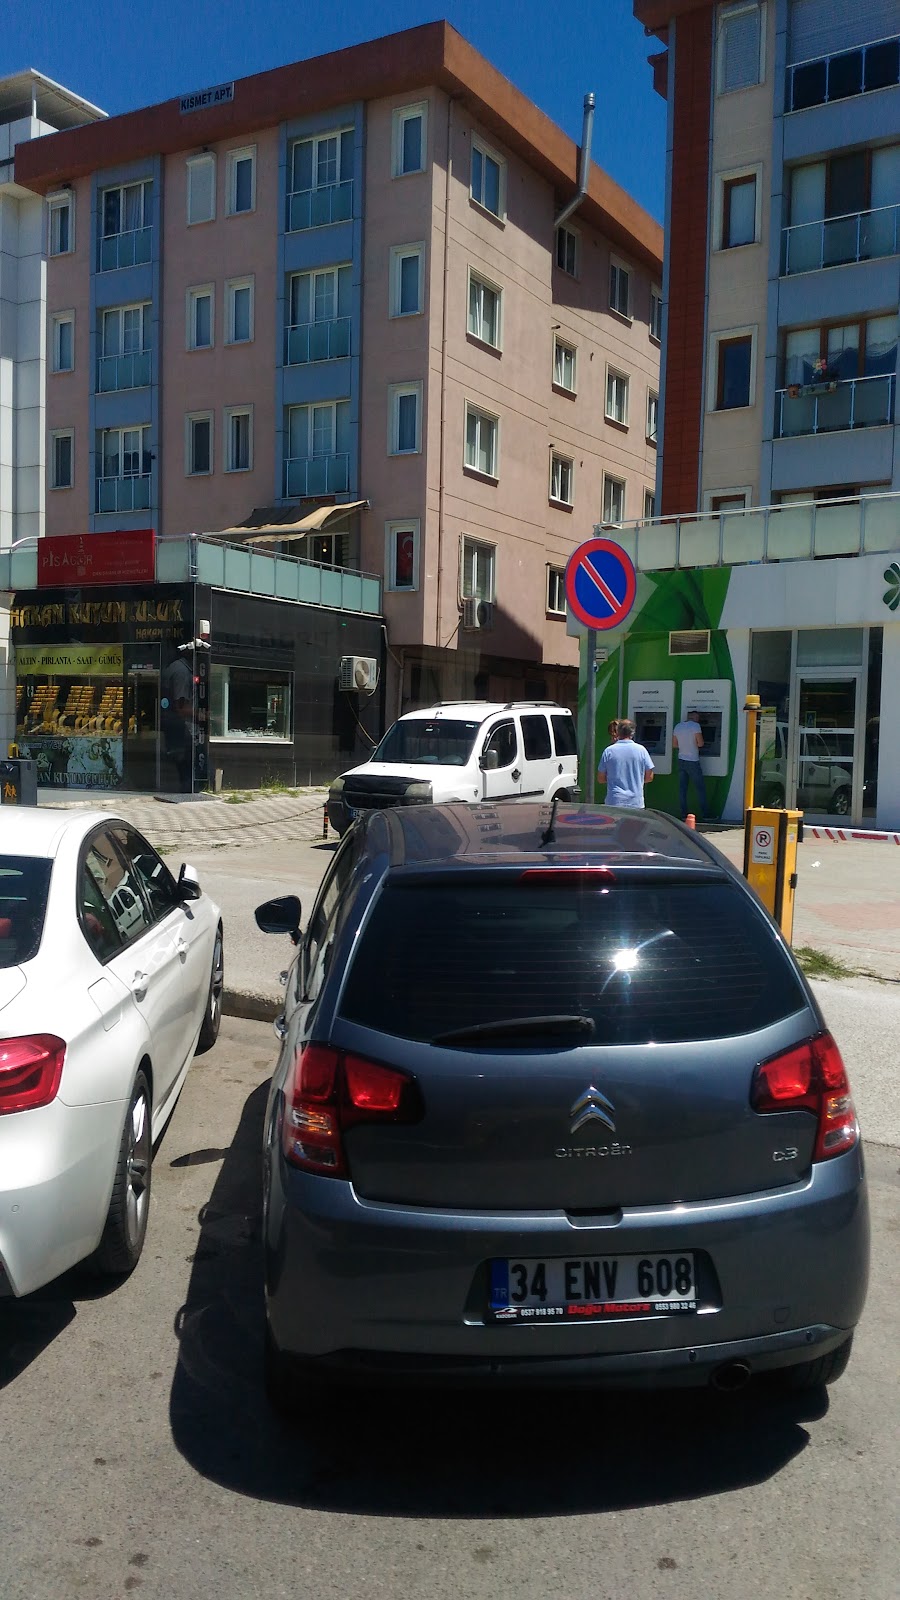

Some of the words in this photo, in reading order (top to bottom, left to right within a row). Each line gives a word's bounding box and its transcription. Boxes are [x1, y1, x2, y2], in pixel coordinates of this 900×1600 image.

[181, 92, 212, 111] KISMET
[214, 86, 232, 101] APT.
[19, 656, 36, 666] ALTIN
[41, 656, 72, 665] PIRLANTA
[76, 656, 93, 665] SAAT
[98, 653, 122, 667] GÜMÜŞ
[494, 1288, 508, 1299] TR
[511, 1263, 548, 1302] 34
[564, 1260, 618, 1301] ENV
[637, 1257, 692, 1299] 608
[604, 1303, 651, 1313] Motors
